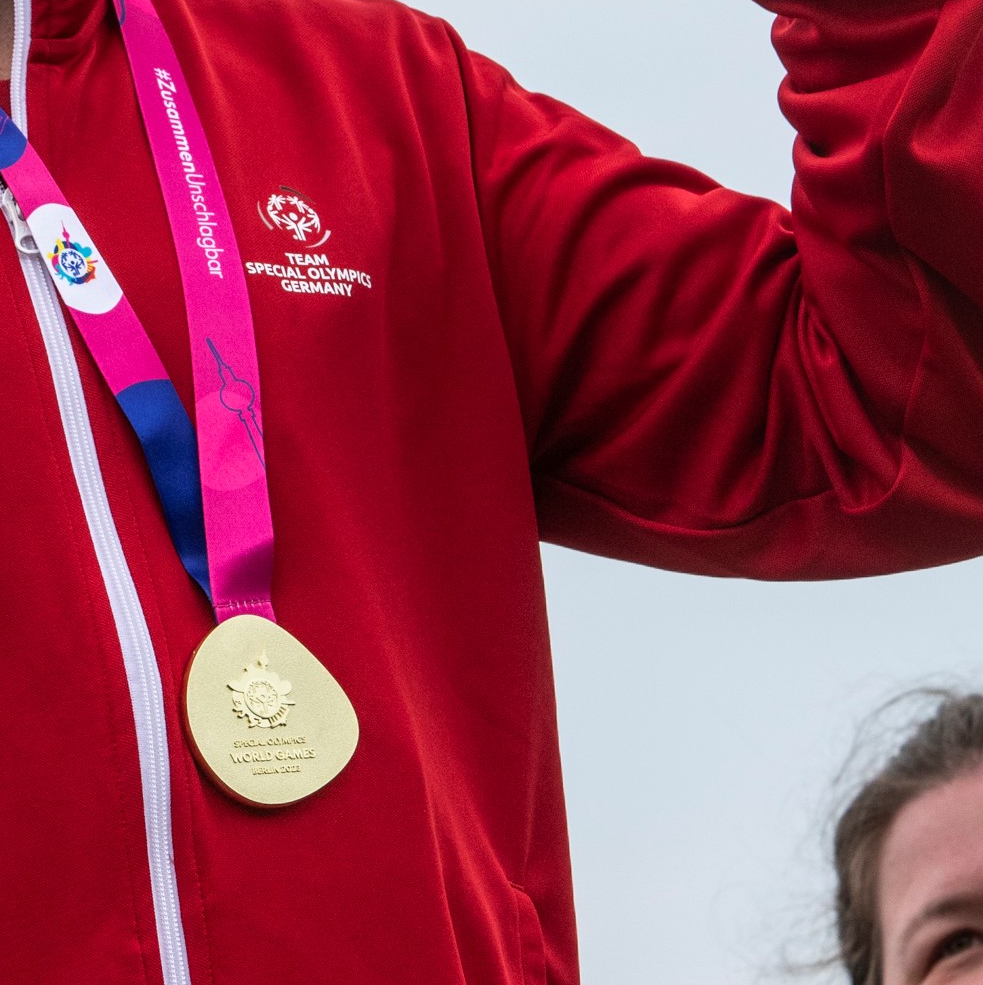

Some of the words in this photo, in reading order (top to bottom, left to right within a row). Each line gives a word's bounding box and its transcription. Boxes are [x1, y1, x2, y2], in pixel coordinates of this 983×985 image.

[153, 67, 224, 279] #ZusammenUnschlagbar
[284, 252, 330, 266] TEAM
[245, 261, 307, 280] SPECIAL
[307, 267, 372, 289] OLYMPICS
[281, 279, 353, 297] GERMANY
[229, 750, 273, 764] WORLD
[275, 748, 316, 760] GAMES
